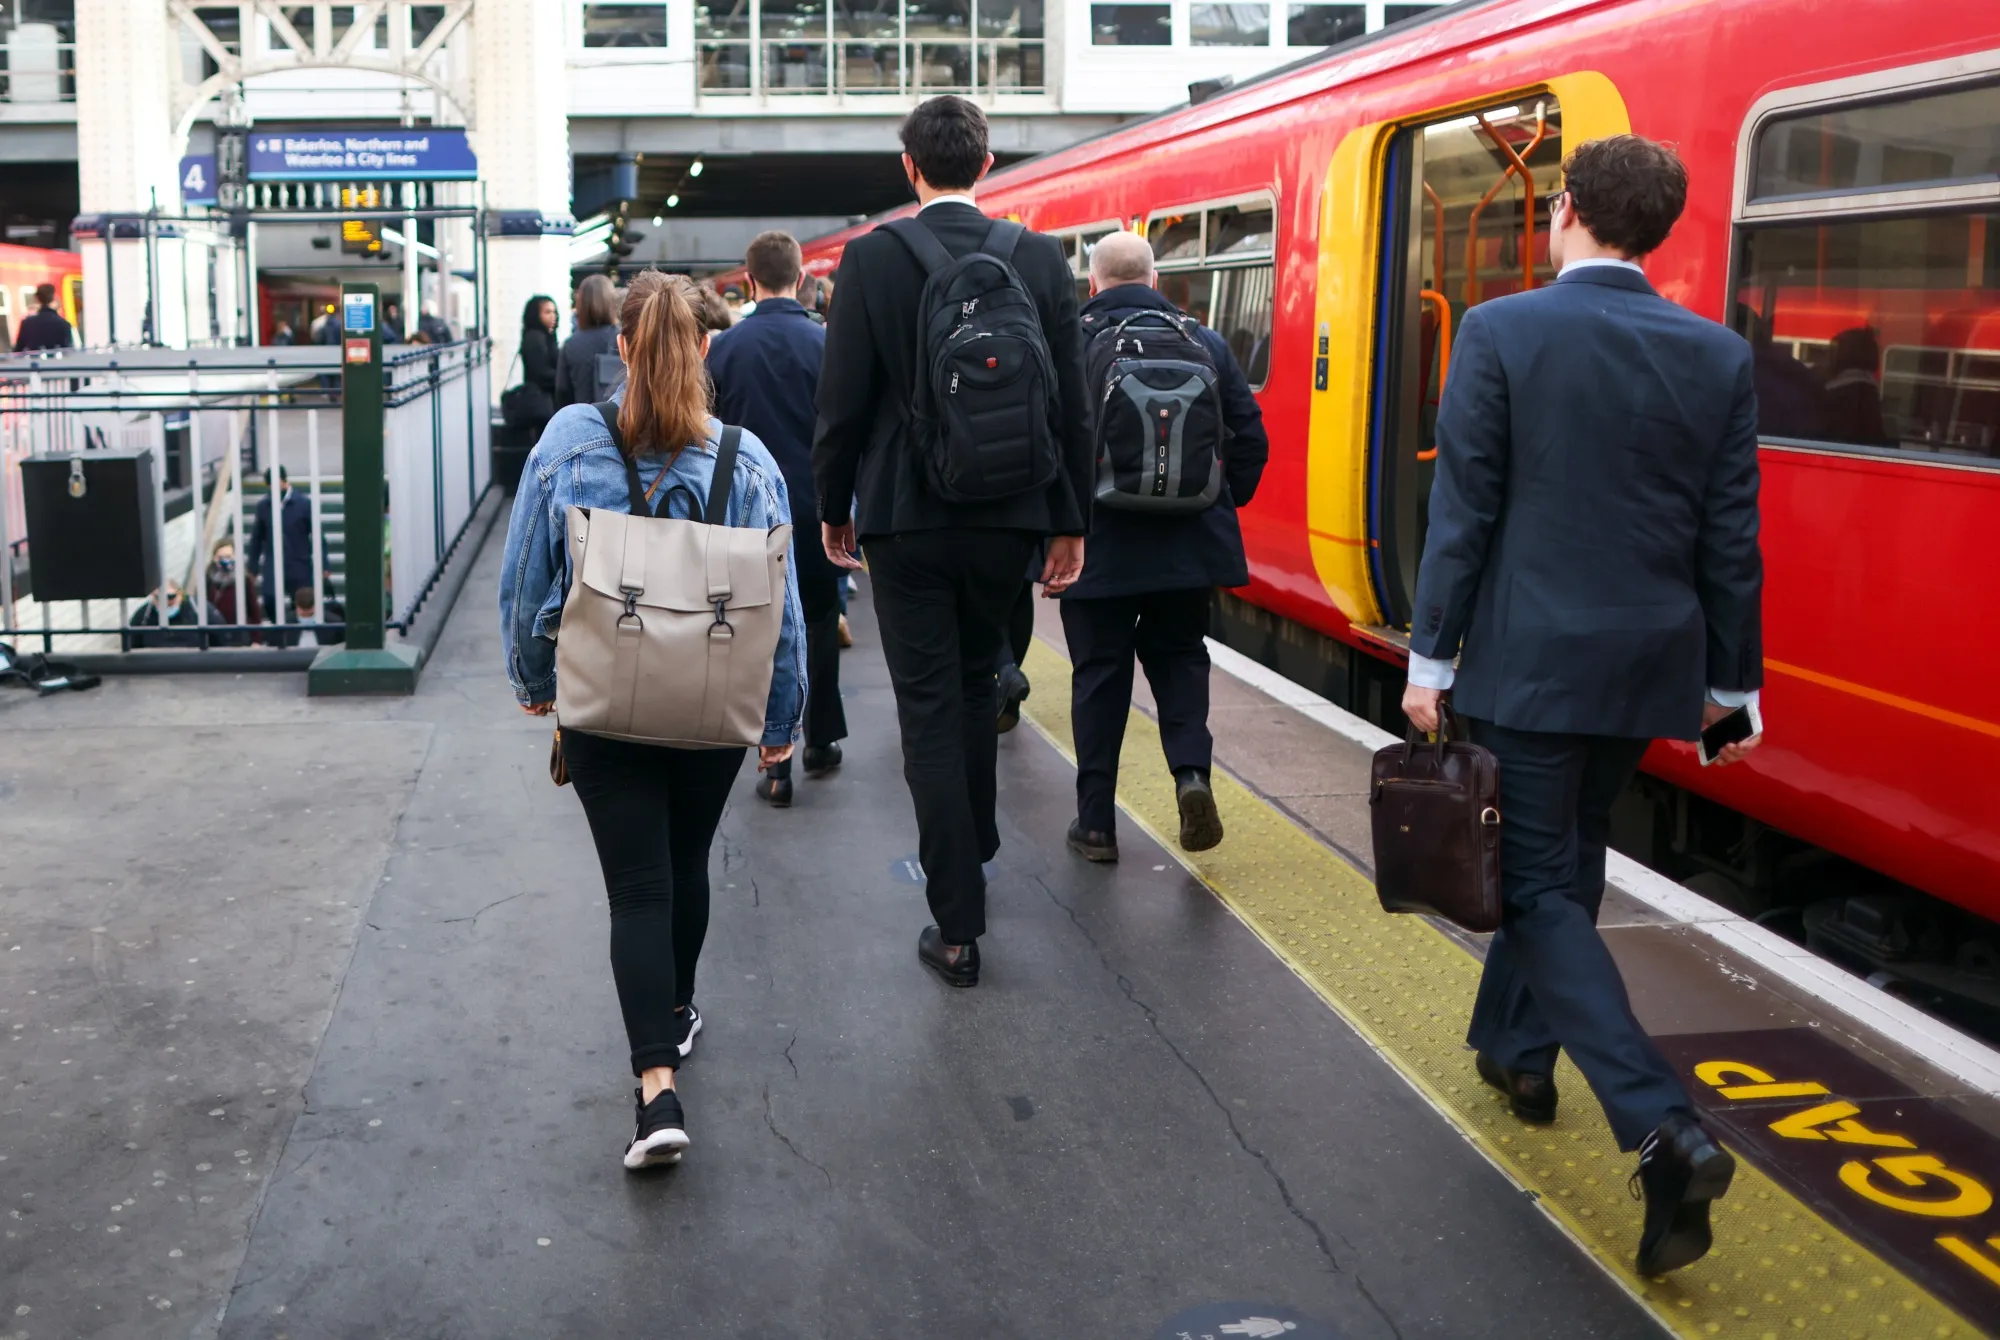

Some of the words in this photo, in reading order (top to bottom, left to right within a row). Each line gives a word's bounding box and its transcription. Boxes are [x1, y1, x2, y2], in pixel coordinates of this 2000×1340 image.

[345, 138, 403, 151] Northern
[404, 137, 429, 151] and
[285, 153, 344, 167] Waterloo
[346, 153, 356, 166] &
[358, 152, 384, 168] City
[386, 152, 417, 166] lines
[183, 163, 207, 192] 4
[1694, 1060, 1993, 1217] GAP
